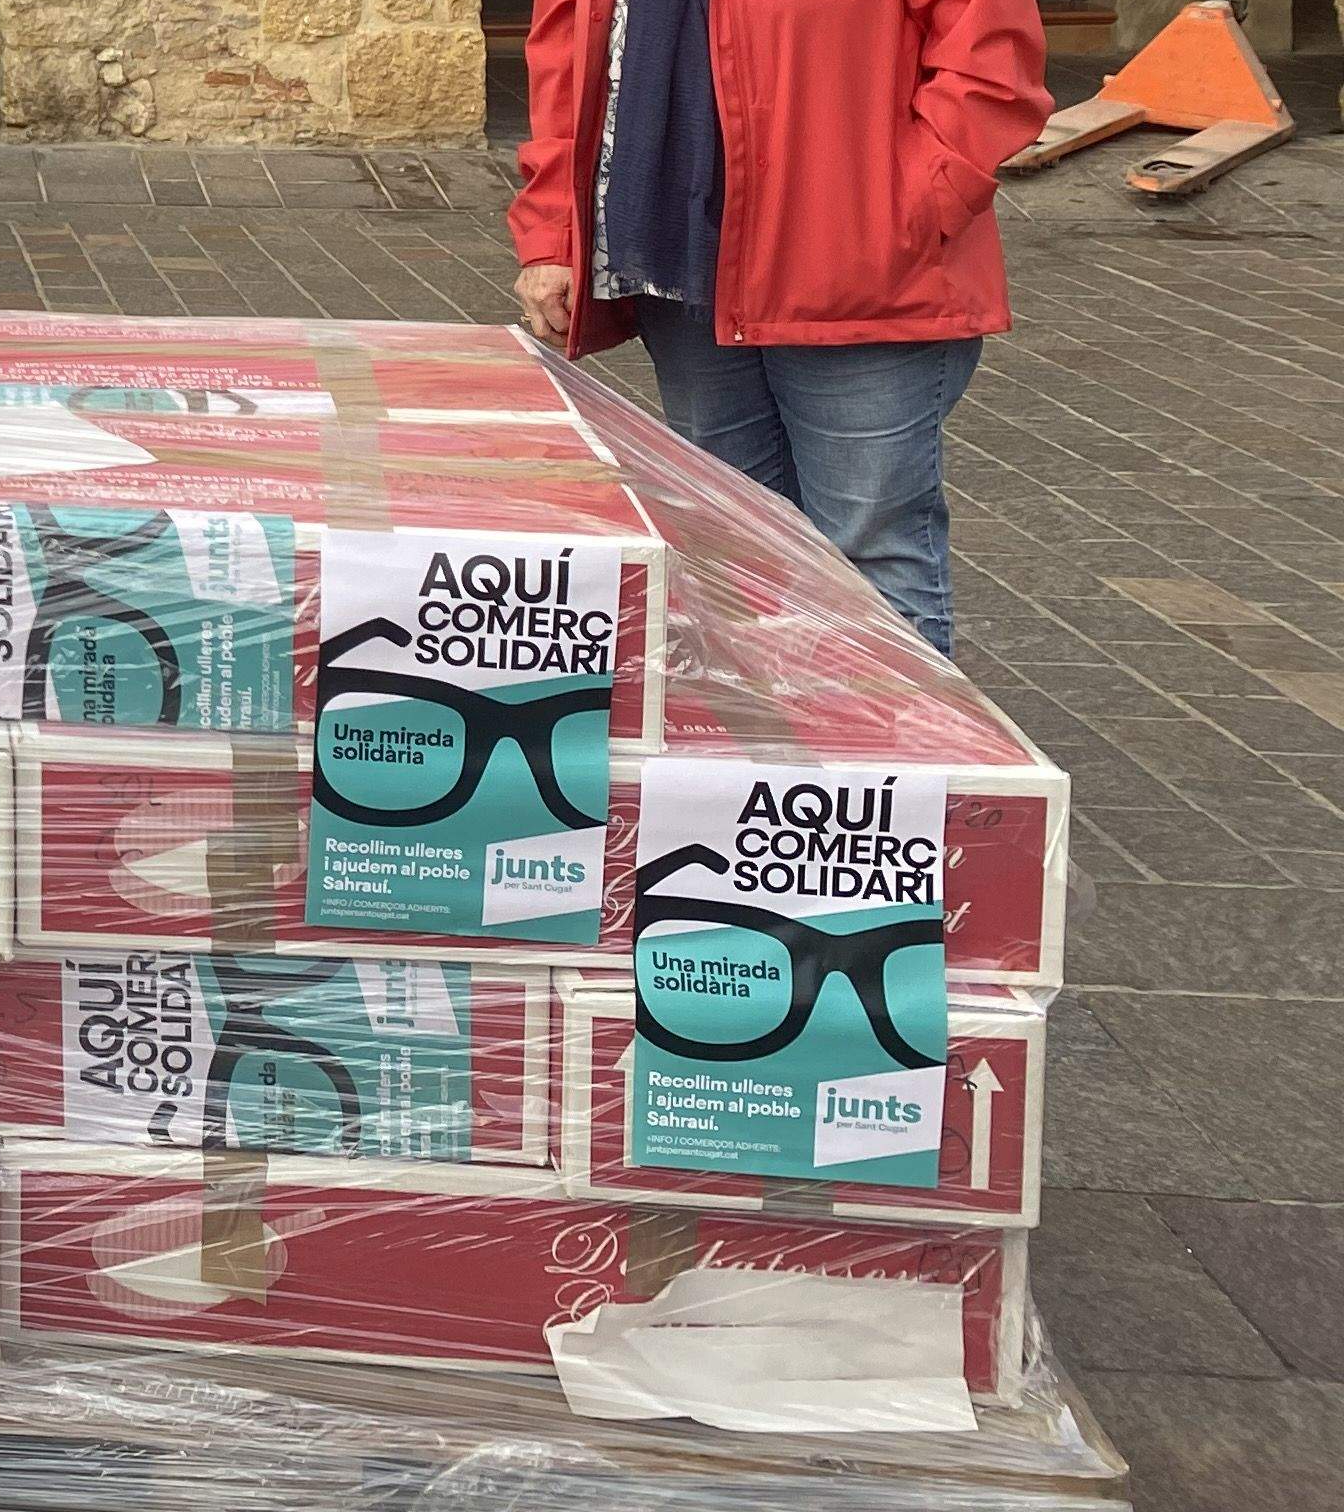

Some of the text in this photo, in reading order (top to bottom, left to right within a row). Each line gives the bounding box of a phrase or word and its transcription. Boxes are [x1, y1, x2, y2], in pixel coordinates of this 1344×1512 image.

[419, 548, 574, 606] AQUÍ
[418, 601, 612, 650] COMERÇ
[414, 634, 609, 675] SOLIDARI
[333, 743, 424, 765] solidària
[334, 724, 454, 748] Una mirada
[737, 776, 898, 834] AQUÍ
[325, 838, 462, 860] Recollim ulleres
[491, 849, 586, 885] junts
[736, 827, 937, 880] COMERÇ
[323, 876, 392, 894] Sahrauí.
[332, 859, 397, 879] ajudem
[401, 861, 415, 877] al
[419, 864, 470, 883] poble
[734, 861, 934, 905] SOLIDARI
[652, 951, 780, 981] Una mirada
[653, 974, 750, 998] solidària
[65, 959, 126, 1095] AQUÍ
[126, 950, 159, 1096] COMER
[160, 951, 193, 1097] SOLIDA
[648, 1071, 793, 1097] Recollim ulleres
[648, 1111, 719, 1131] Sahrauí.
[656, 1094, 724, 1114] ajudem
[728, 1096, 744, 1113] al
[748, 1099, 801, 1118] poble
[823, 1088, 922, 1124] junts
